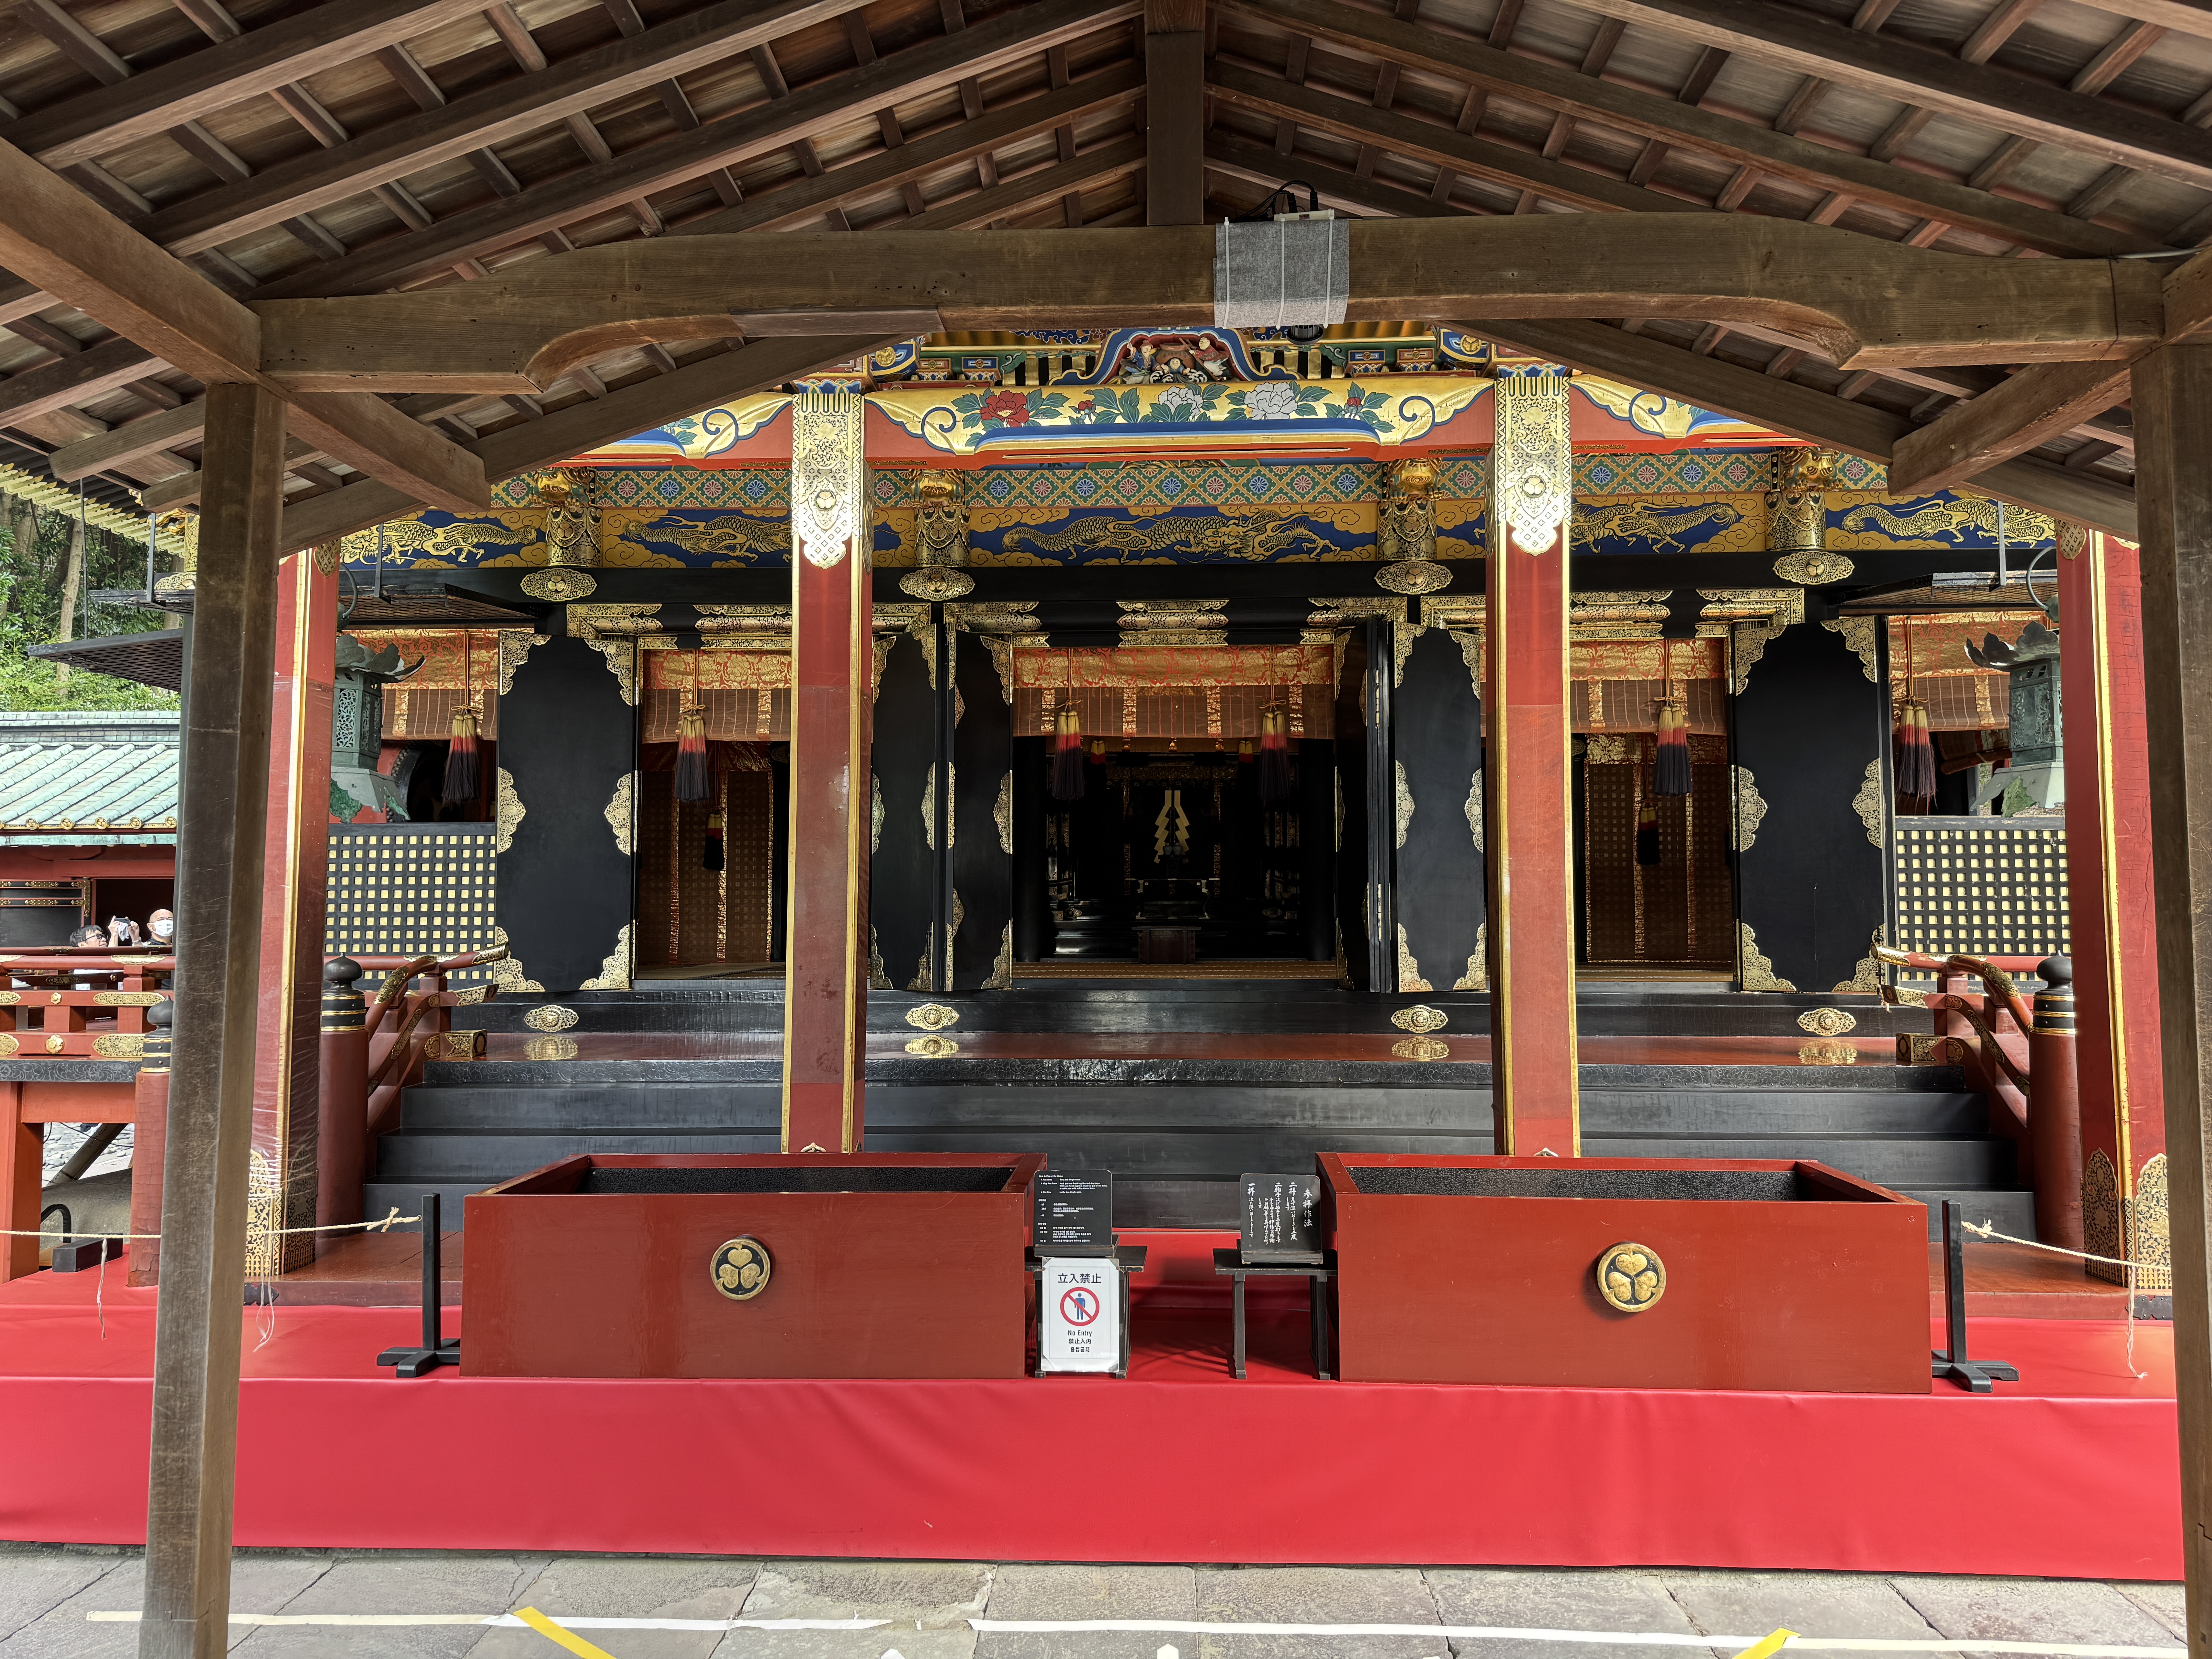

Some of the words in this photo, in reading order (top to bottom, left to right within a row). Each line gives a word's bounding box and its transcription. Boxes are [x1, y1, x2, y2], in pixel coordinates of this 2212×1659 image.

[1302, 1188, 1313, 1227] 参拝作法
[1058, 1273, 1101, 1283] 立入禁止
